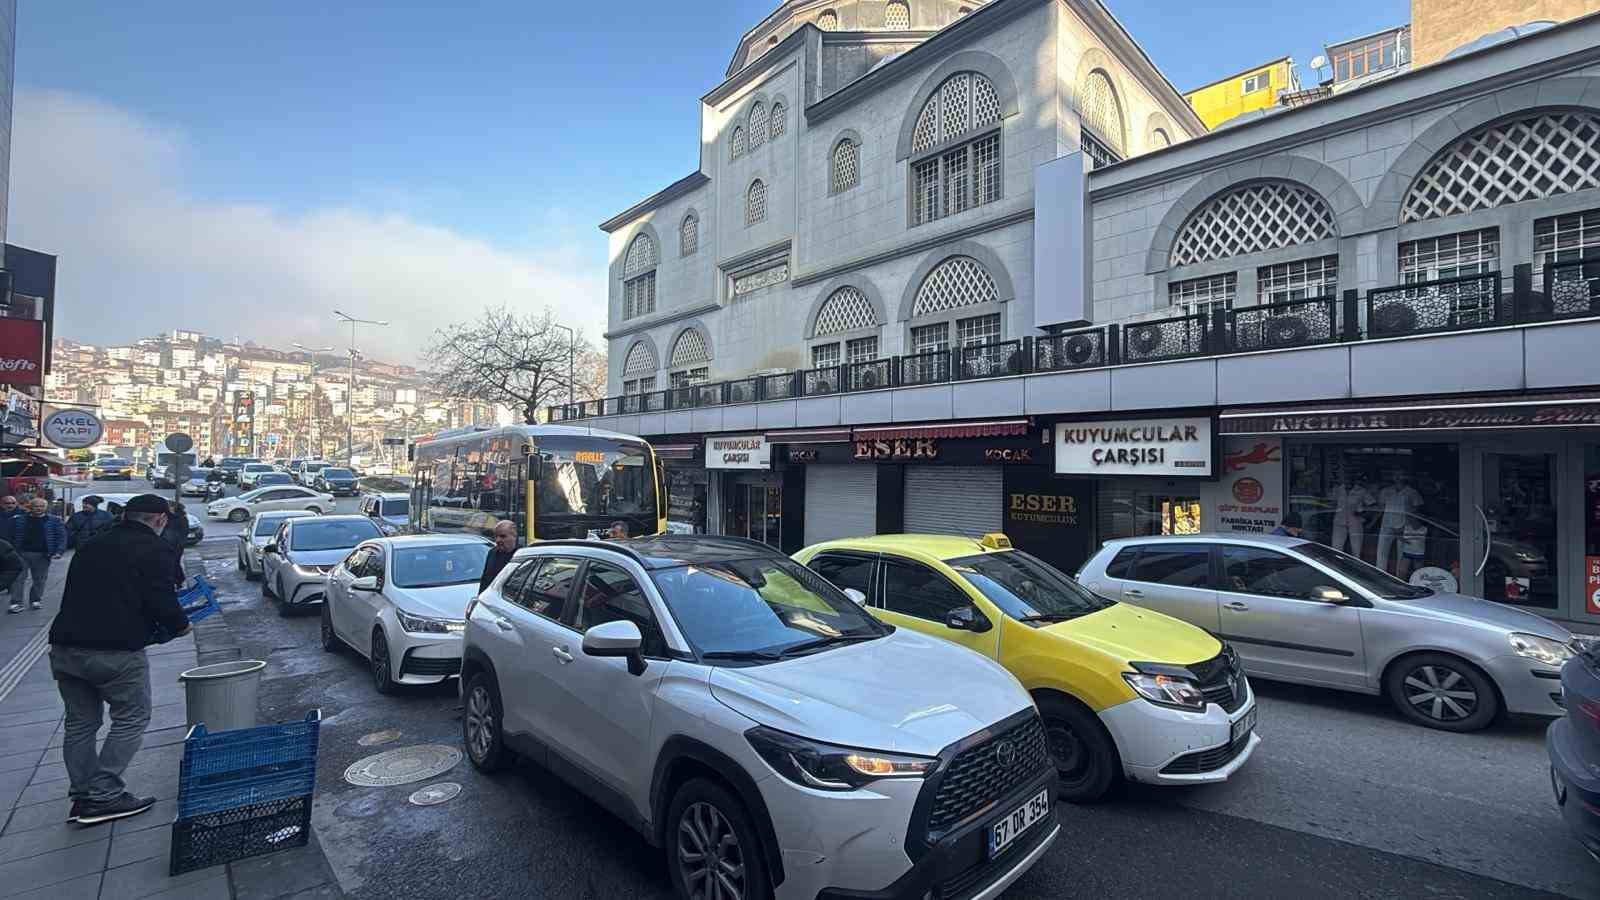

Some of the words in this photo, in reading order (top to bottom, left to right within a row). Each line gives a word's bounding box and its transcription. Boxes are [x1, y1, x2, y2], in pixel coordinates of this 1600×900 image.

[52, 417, 96, 426] AKEL
[57, 427, 91, 435] YAPI
[1064, 425, 1199, 444] KUYUMCULAR
[713, 439, 760, 450] KUYUMCULAR
[854, 438, 937, 459] ESER
[723, 453, 750, 464] ÇARŞISI
[1092, 448, 1165, 466] ÇARŞISI
[1009, 494, 1077, 512] ESER
[1010, 512, 1078, 524] KUYUMCULUK
[1221, 517, 1252, 525] FABRİKA
[995, 819, 1008, 847] 67
[1012, 808, 1026, 835] DR
[1029, 792, 1047, 821] 354
